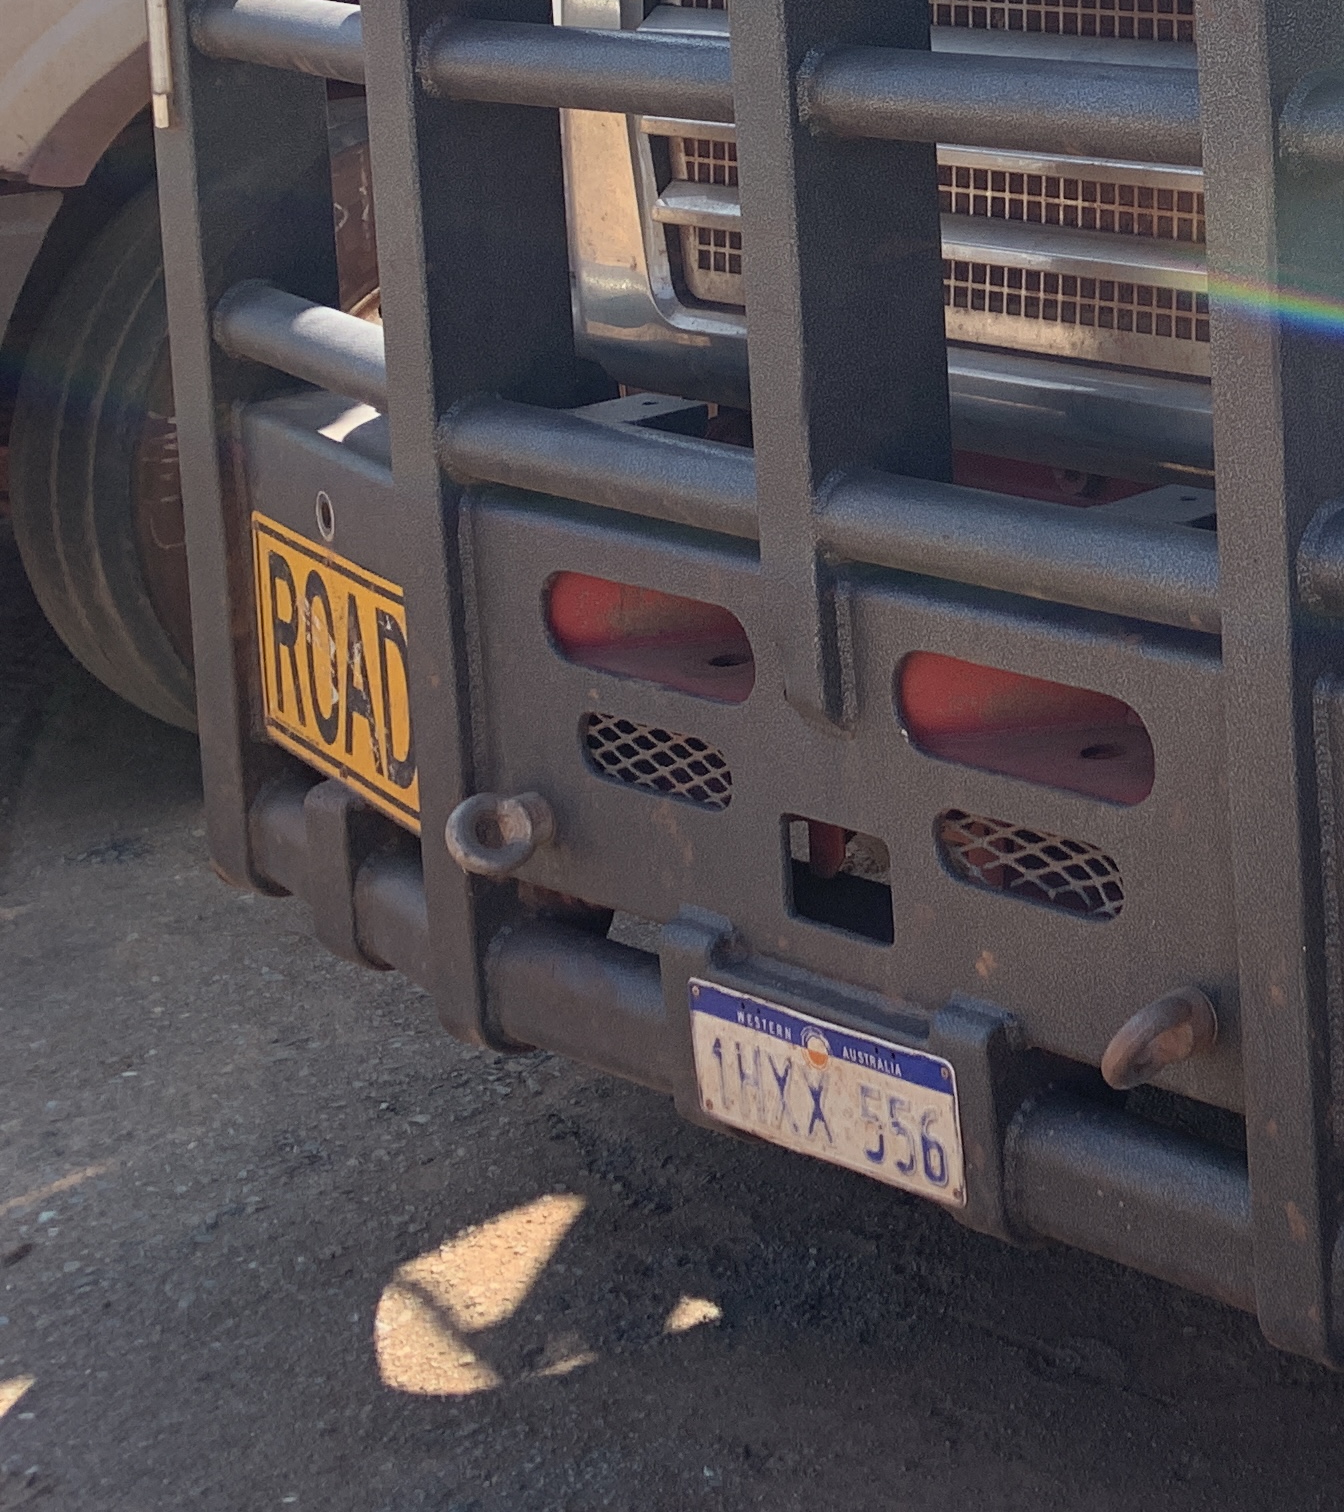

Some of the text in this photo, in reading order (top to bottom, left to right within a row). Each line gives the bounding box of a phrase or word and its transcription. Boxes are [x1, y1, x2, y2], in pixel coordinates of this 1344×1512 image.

[267, 549, 418, 790] ROAD
[735, 1010, 903, 1078] WESTERN AUSTRALIA
[858, 1082, 949, 1186] 556
